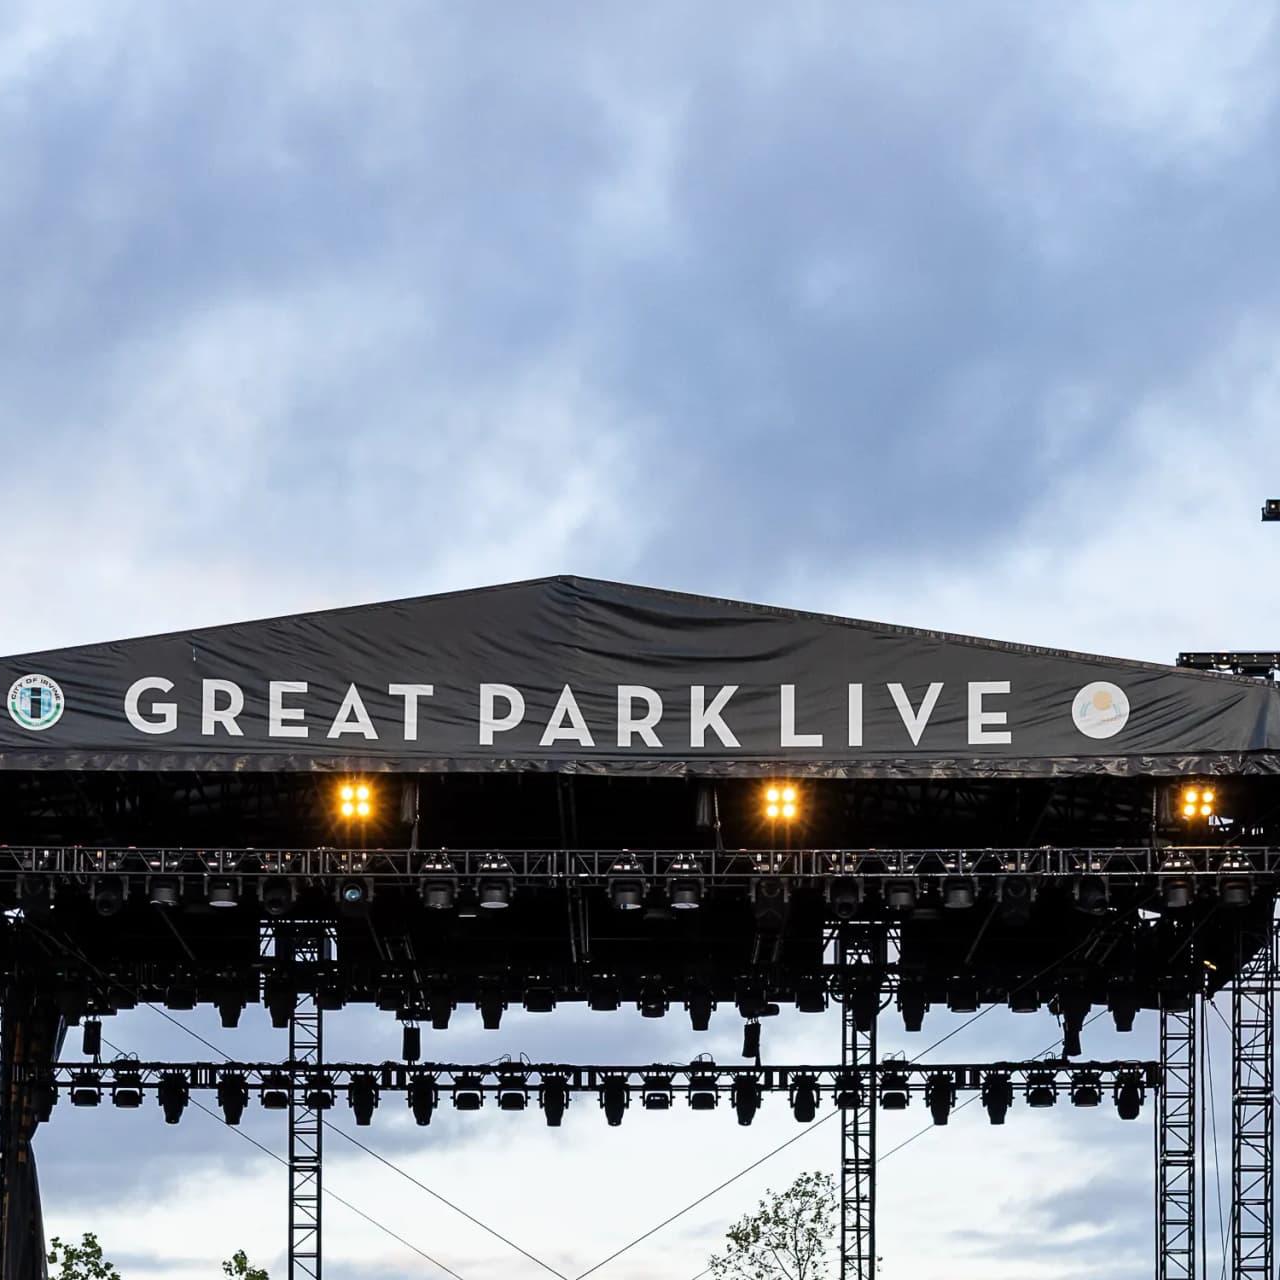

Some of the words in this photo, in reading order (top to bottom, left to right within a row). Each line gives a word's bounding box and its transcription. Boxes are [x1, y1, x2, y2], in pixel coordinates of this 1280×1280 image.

[11, 682, 23, 700] CITY
[40, 678, 61, 701] IRVINE
[124, 676, 434, 741] GREAT
[478, 683, 741, 748] PARK
[780, 681, 1012, 747] LIVE
